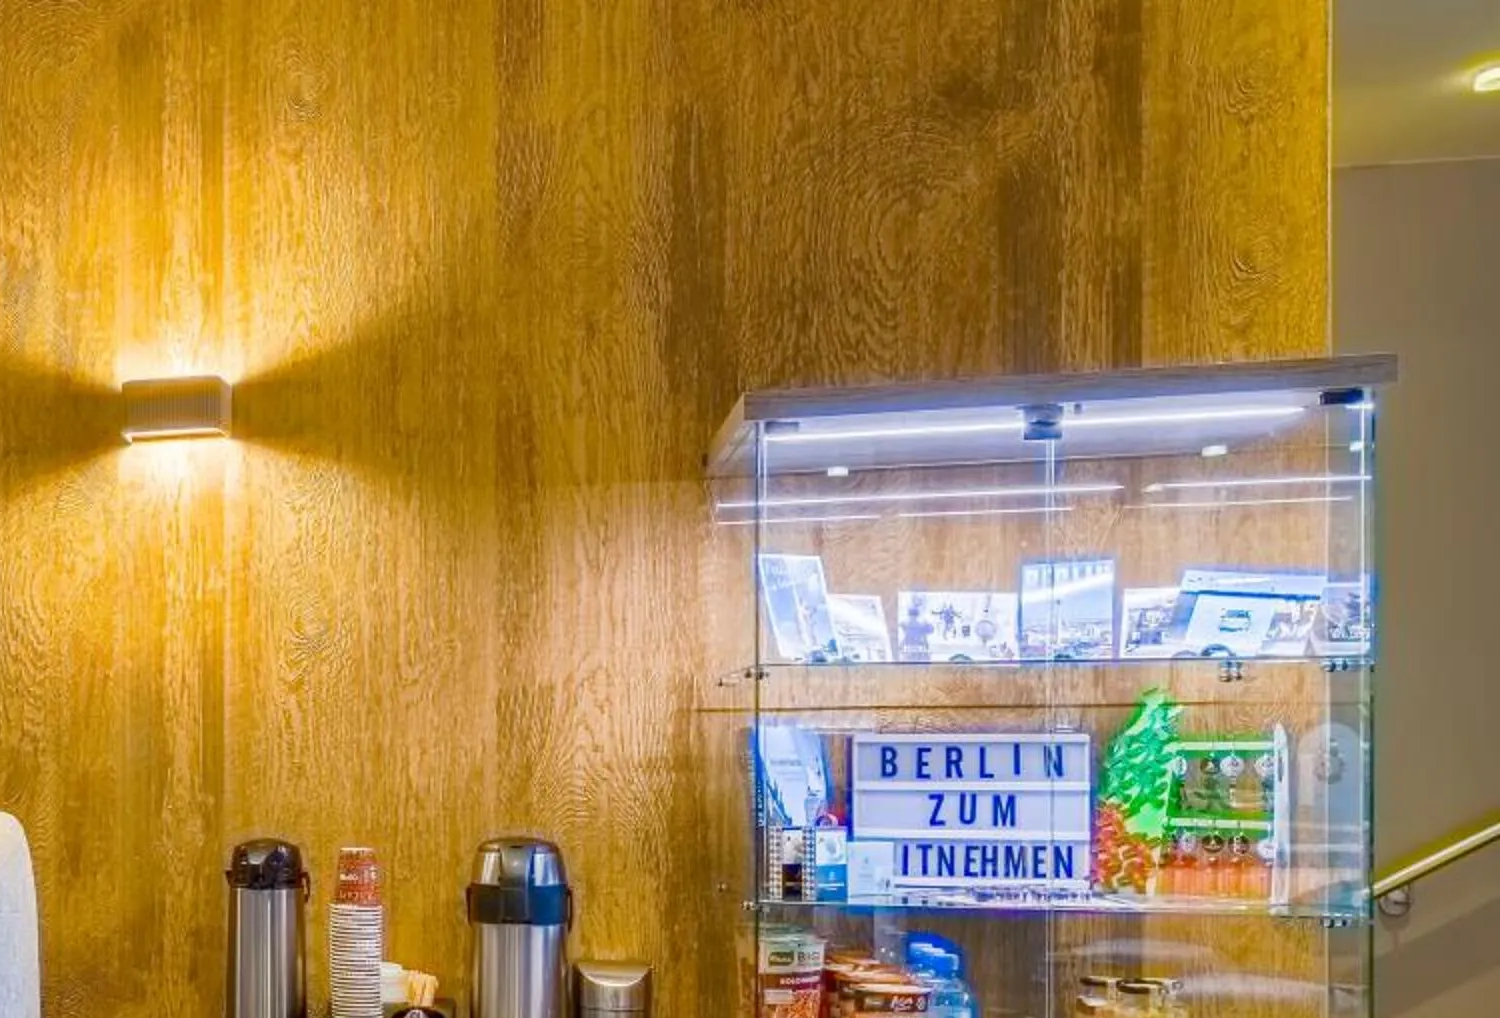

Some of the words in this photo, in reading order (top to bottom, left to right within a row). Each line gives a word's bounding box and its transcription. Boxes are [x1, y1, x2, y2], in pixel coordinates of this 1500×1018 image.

[880, 743, 1064, 779] BERLIN
[928, 793, 1016, 827] ZUM
[901, 844, 1073, 879] ITNEHMEN
